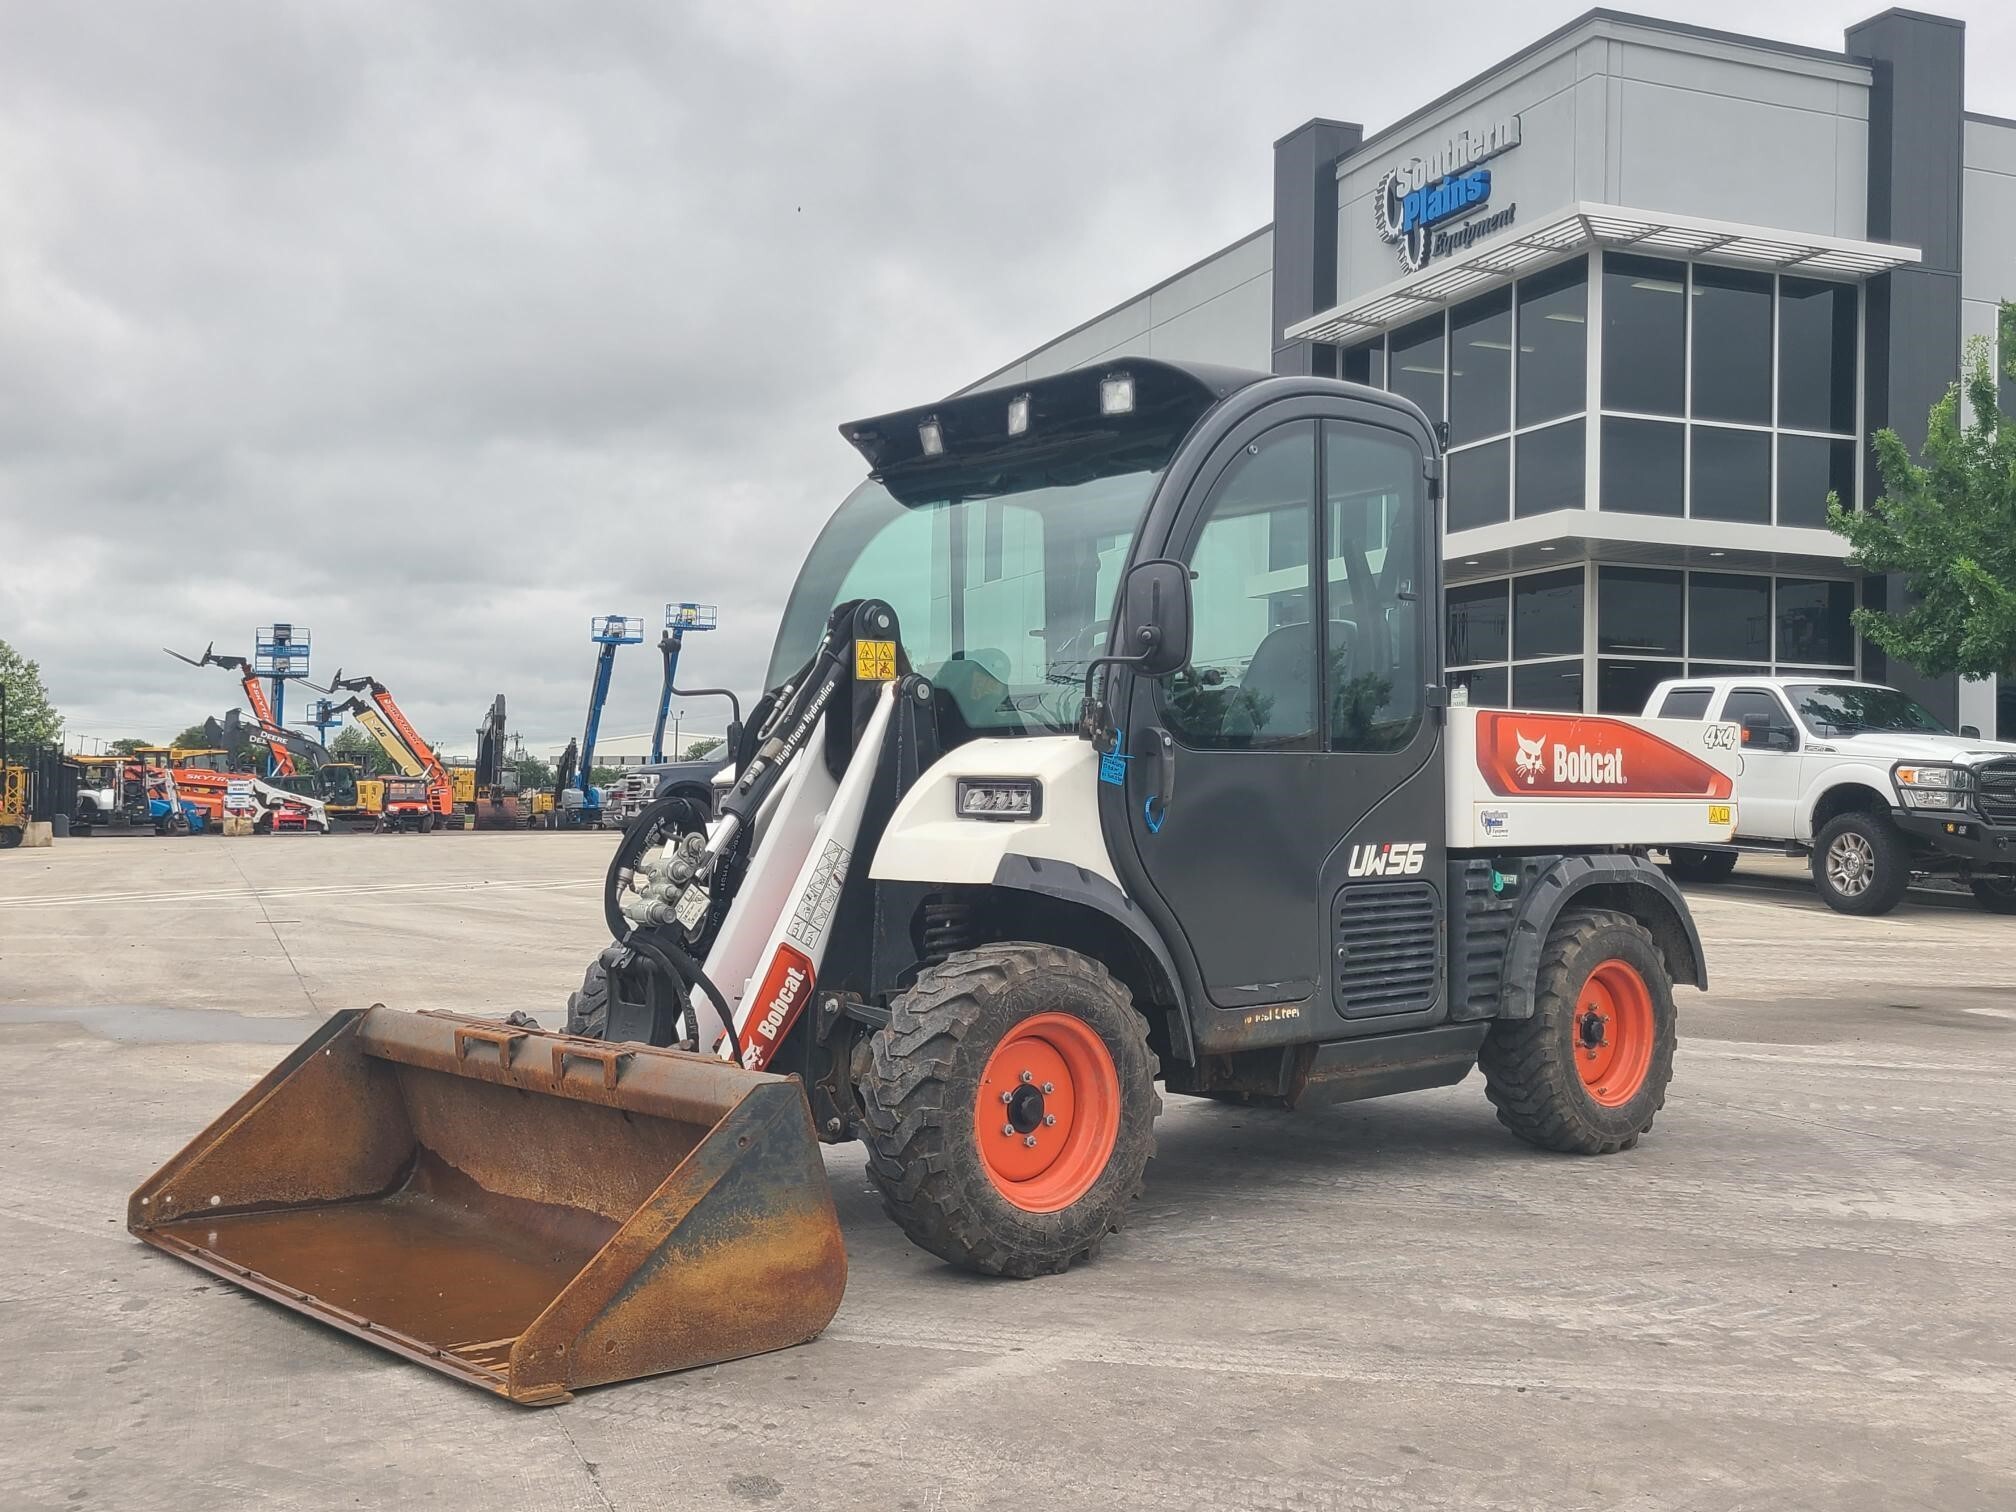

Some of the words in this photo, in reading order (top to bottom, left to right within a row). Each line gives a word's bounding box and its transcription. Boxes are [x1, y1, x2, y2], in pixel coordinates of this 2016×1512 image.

[1396, 114, 1521, 197] Southern
[1402, 170, 1491, 233] Plains
[1432, 203, 1516, 257] Equipment
[260, 731, 288, 744] DEERE
[374, 726, 387, 738] JLG
[774, 744, 793, 766] High
[788, 723, 807, 745] Flow
[803, 680, 835, 723] Hydraulics
[1703, 725, 1736, 750] 4x4
[1554, 744, 1624, 784] Bobcat
[757, 967, 806, 1041] Bobcat
